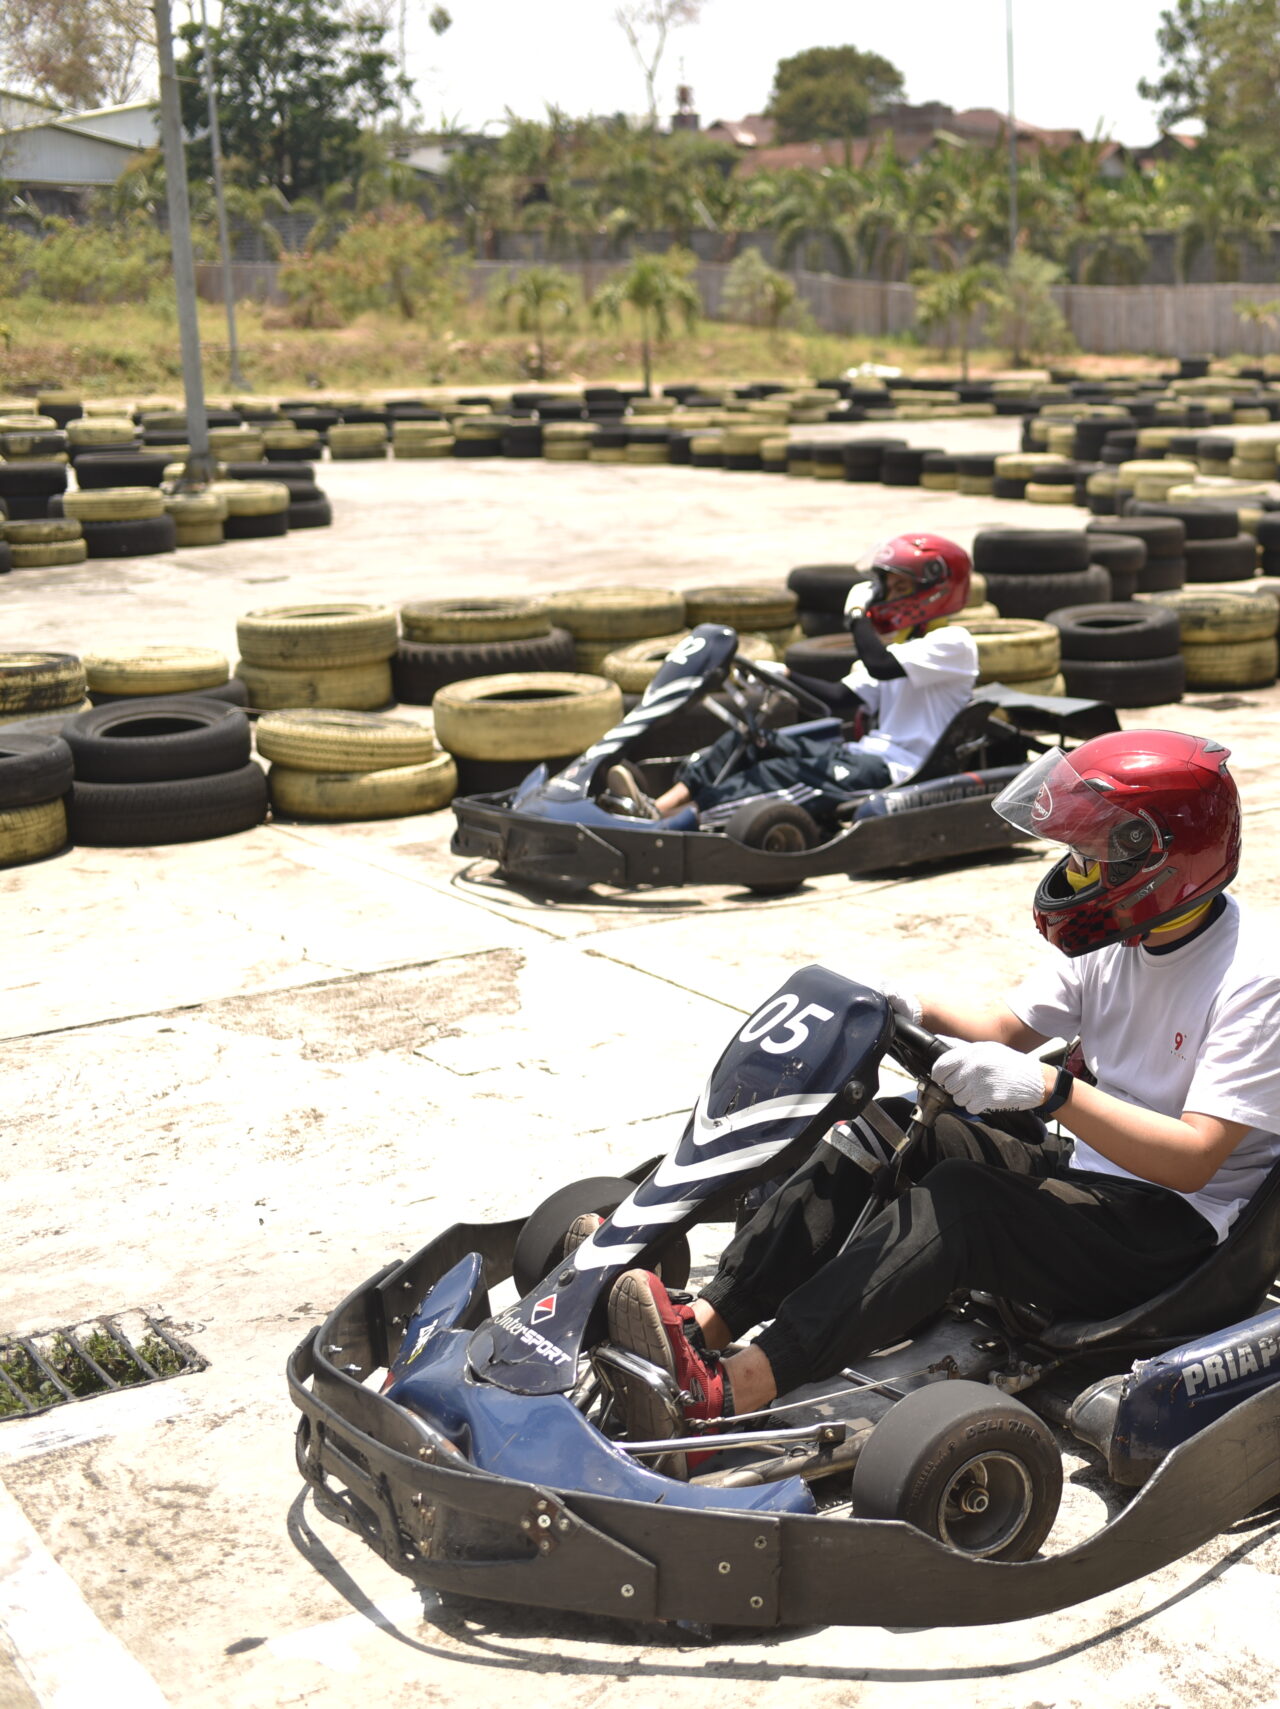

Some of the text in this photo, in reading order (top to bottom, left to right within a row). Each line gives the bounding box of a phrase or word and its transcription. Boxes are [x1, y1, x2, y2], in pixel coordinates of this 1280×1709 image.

[739, 993, 834, 1055] 05
[494, 1306, 572, 1366] InterSPORT
[1181, 1342, 1259, 1397] PRIA
